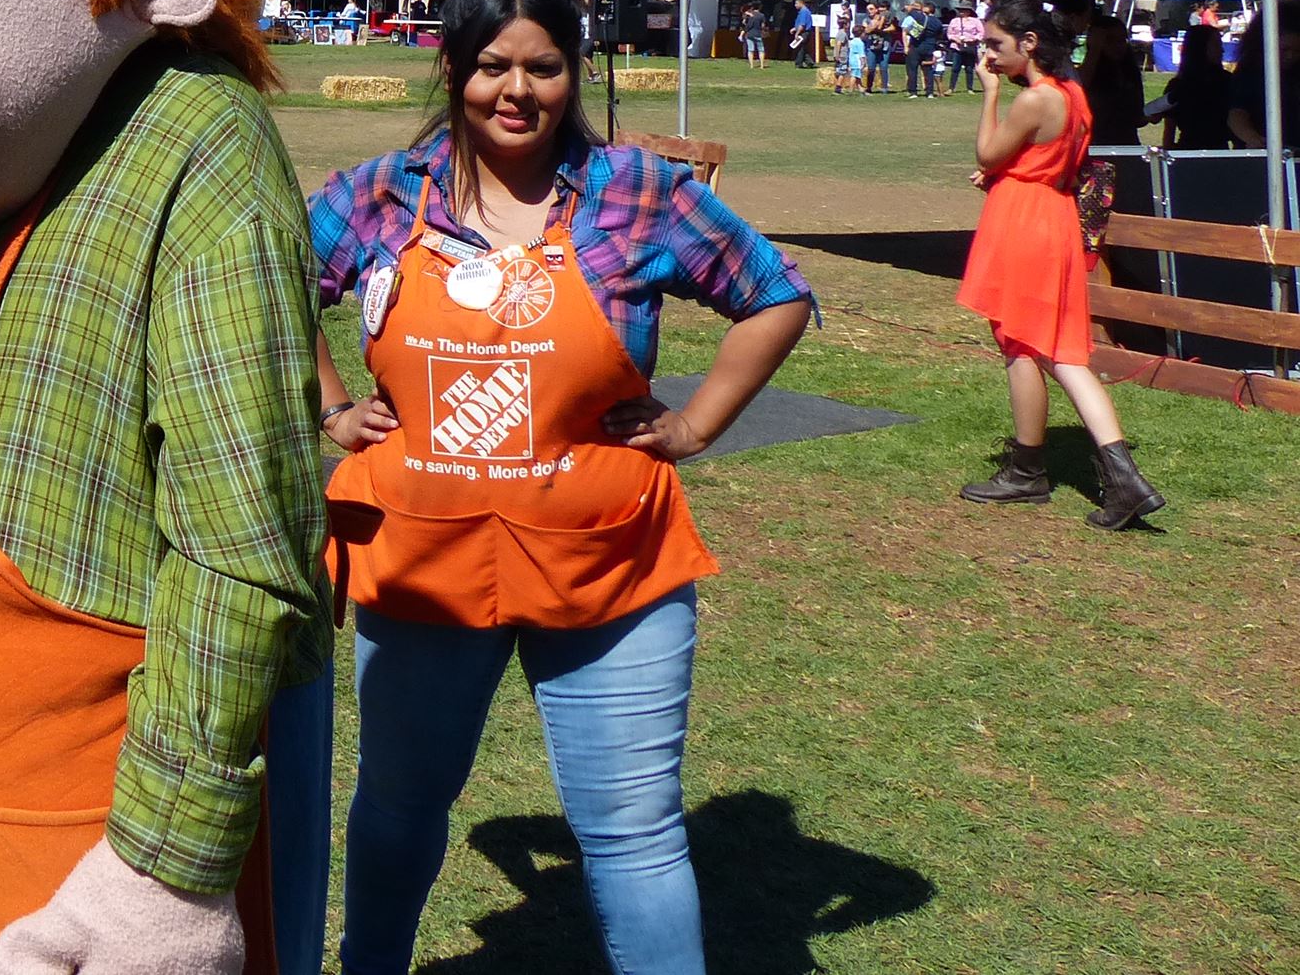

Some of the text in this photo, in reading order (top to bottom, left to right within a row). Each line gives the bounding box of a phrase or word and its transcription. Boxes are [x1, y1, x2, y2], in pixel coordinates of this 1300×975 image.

[456, 268, 491, 281] HIRING!
[461, 261, 484, 271] NOW
[369, 277, 386, 324] Español
[405, 335, 555, 355] We Are The Home Depot
[440, 370, 481, 409] THE
[433, 360, 529, 454] HOME
[471, 396, 529, 457] DEPOT
[405, 455, 423, 470] ore
[426, 460, 481, 479] saving.
[488, 464, 528, 479] More
